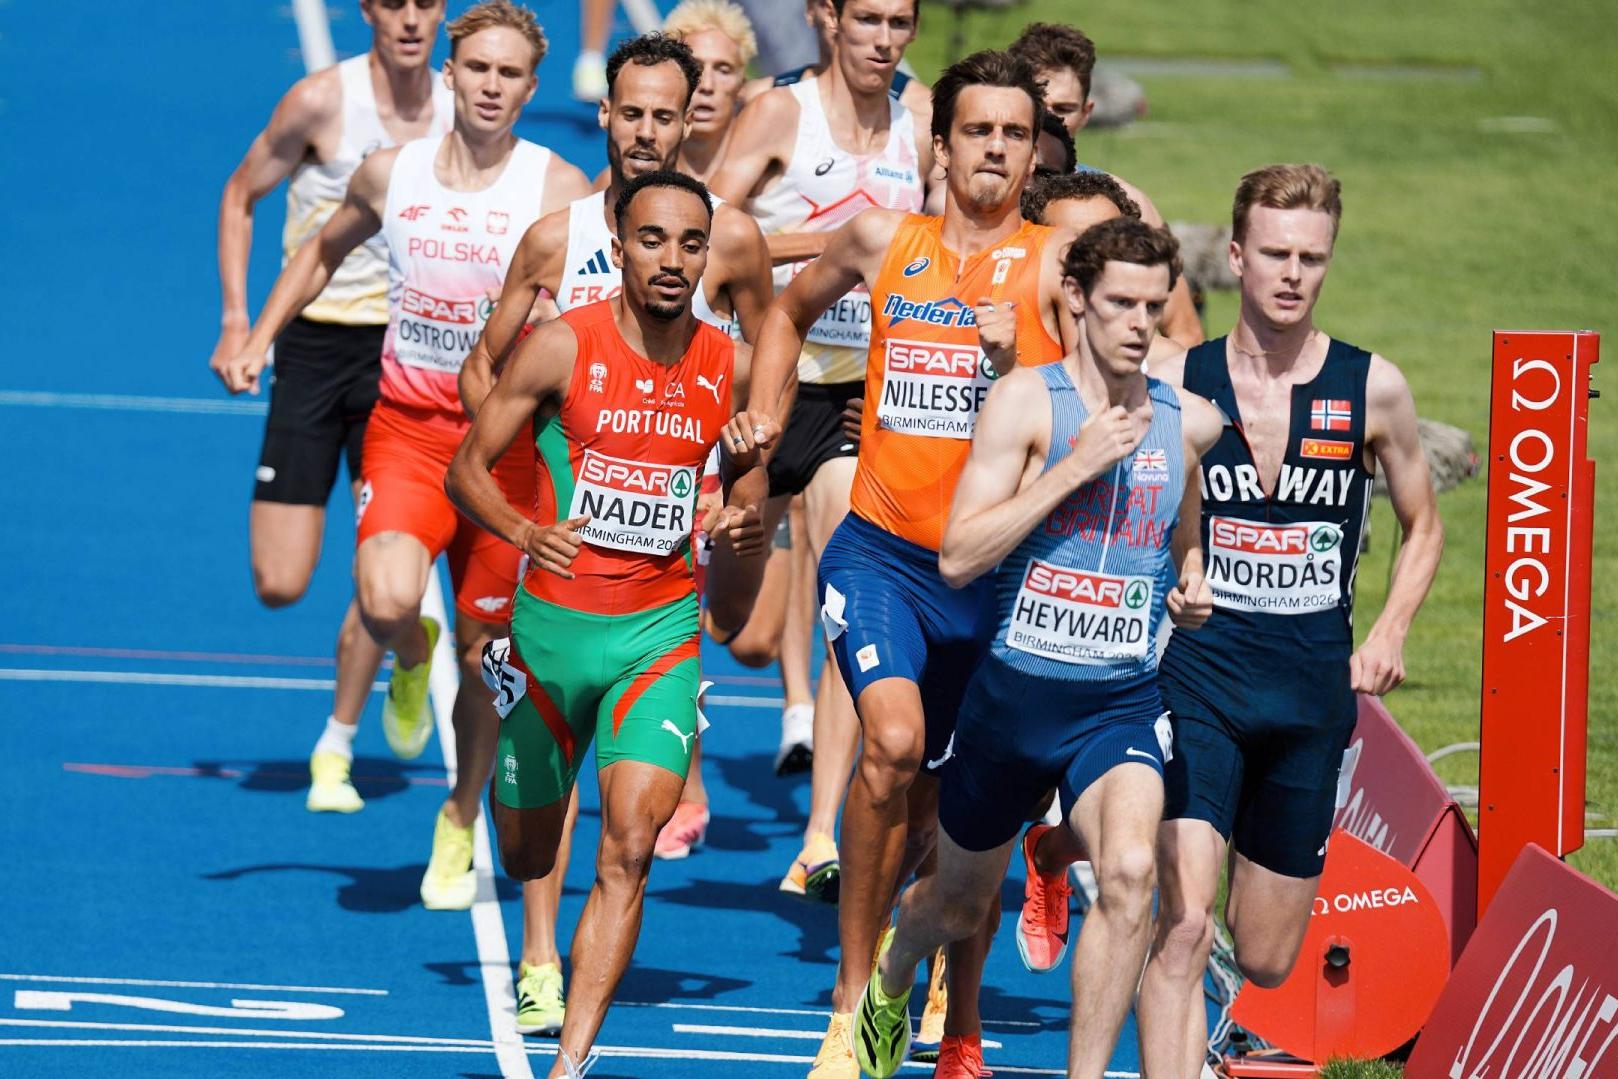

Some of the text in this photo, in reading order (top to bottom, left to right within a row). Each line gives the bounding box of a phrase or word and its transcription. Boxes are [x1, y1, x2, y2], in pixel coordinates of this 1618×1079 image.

[408, 237, 502, 266] POLSKA
[403, 290, 475, 321] SPAR
[400, 319, 483, 352] OSTROW
[890, 346, 975, 375] SPAR
[664, 382, 685, 398] CA
[596, 409, 704, 444] PORTUGAL
[882, 414, 968, 433] BIRMINGHAM
[1320, 445, 1349, 455] EXTRA
[584, 458, 669, 493] SPAR
[580, 489, 684, 532] NADER
[1045, 504, 1165, 549] BRITAIN
[1215, 523, 1307, 551] SPAR
[1503, 429, 1554, 643] OMEGA
[1028, 566, 1123, 605] SPAR
[1210, 553, 1335, 589] NORDÅS
[1211, 588, 1334, 608] BIRMINGHAM 2026
[1016, 596, 1143, 644] HEYWARD
[1014, 631, 1104, 659] BIRMINGHAM
[1334, 885, 1418, 912] OMEGA
